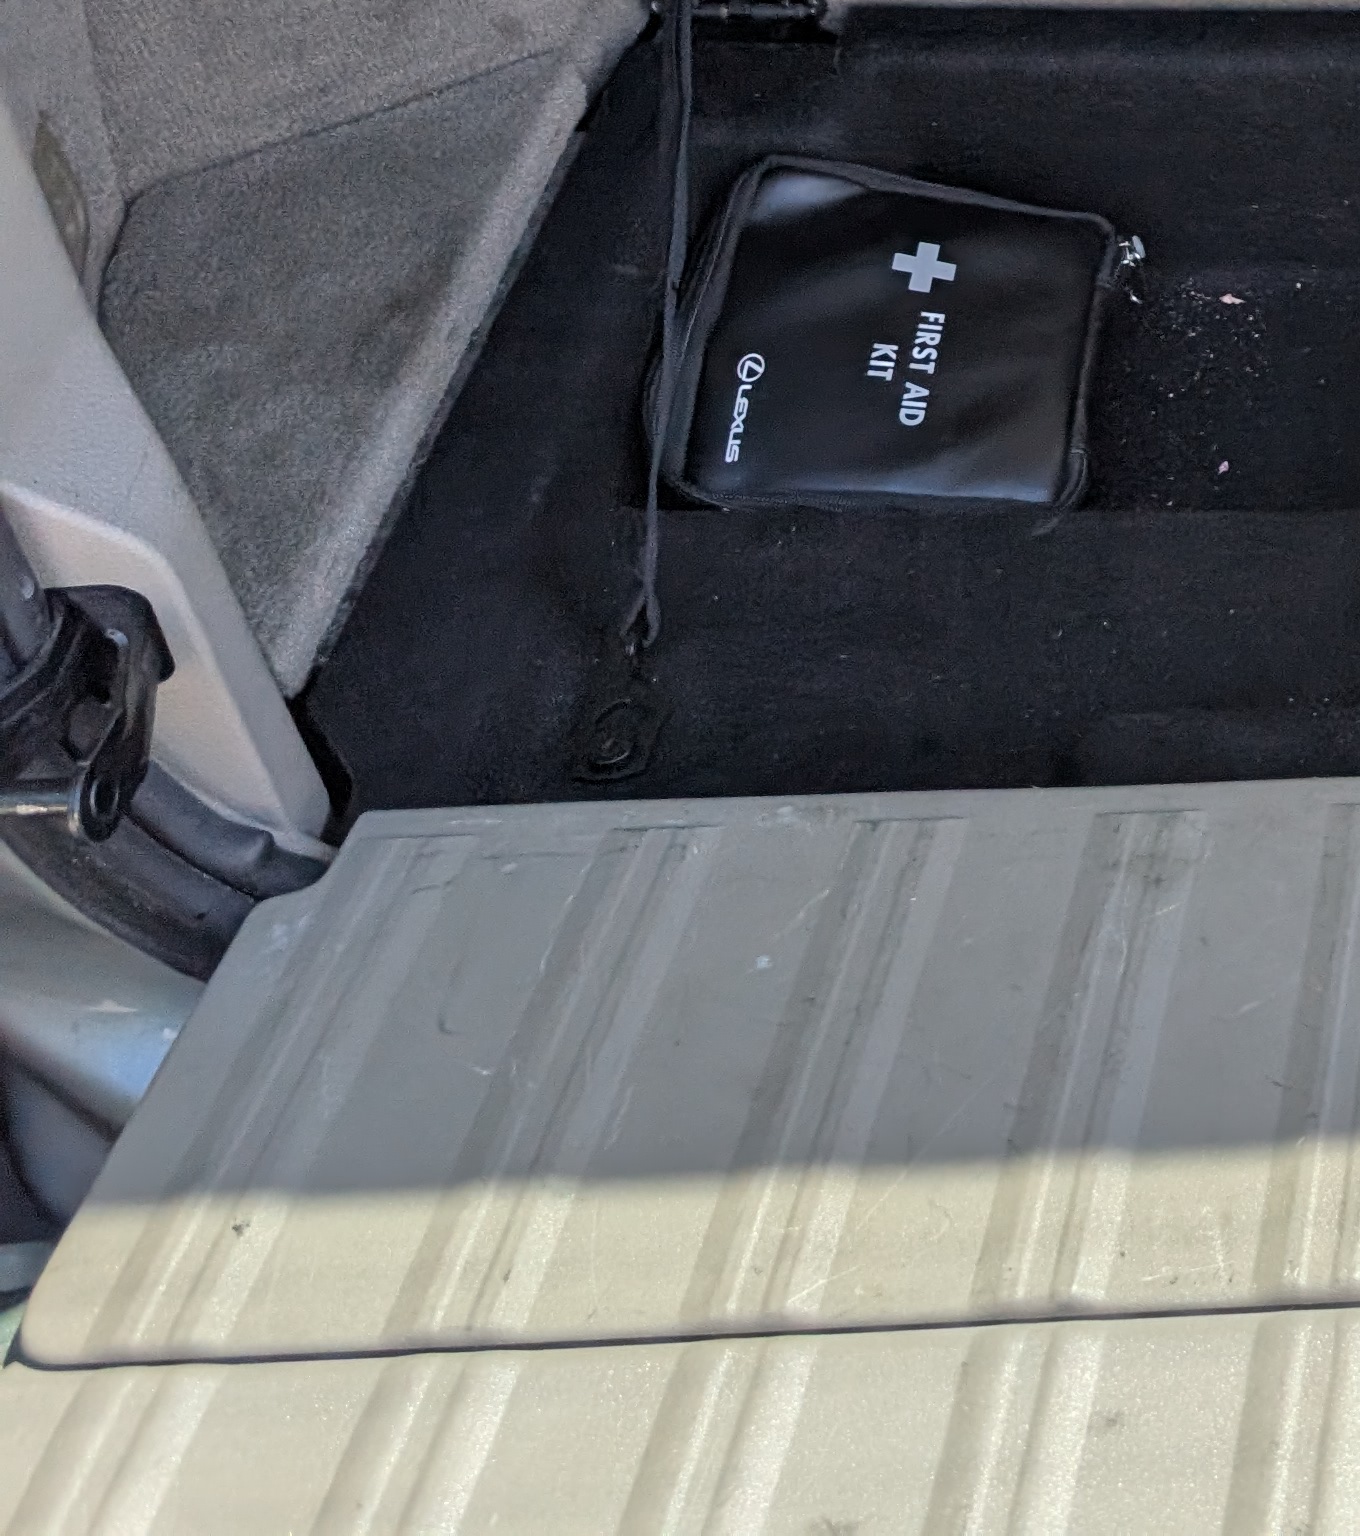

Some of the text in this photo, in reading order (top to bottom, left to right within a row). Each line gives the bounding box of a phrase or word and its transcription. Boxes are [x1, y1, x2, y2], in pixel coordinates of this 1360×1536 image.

[865, 342, 899, 381] KIT
[899, 310, 946, 427] FIRST AID
[724, 383, 753, 463] LEXUS
